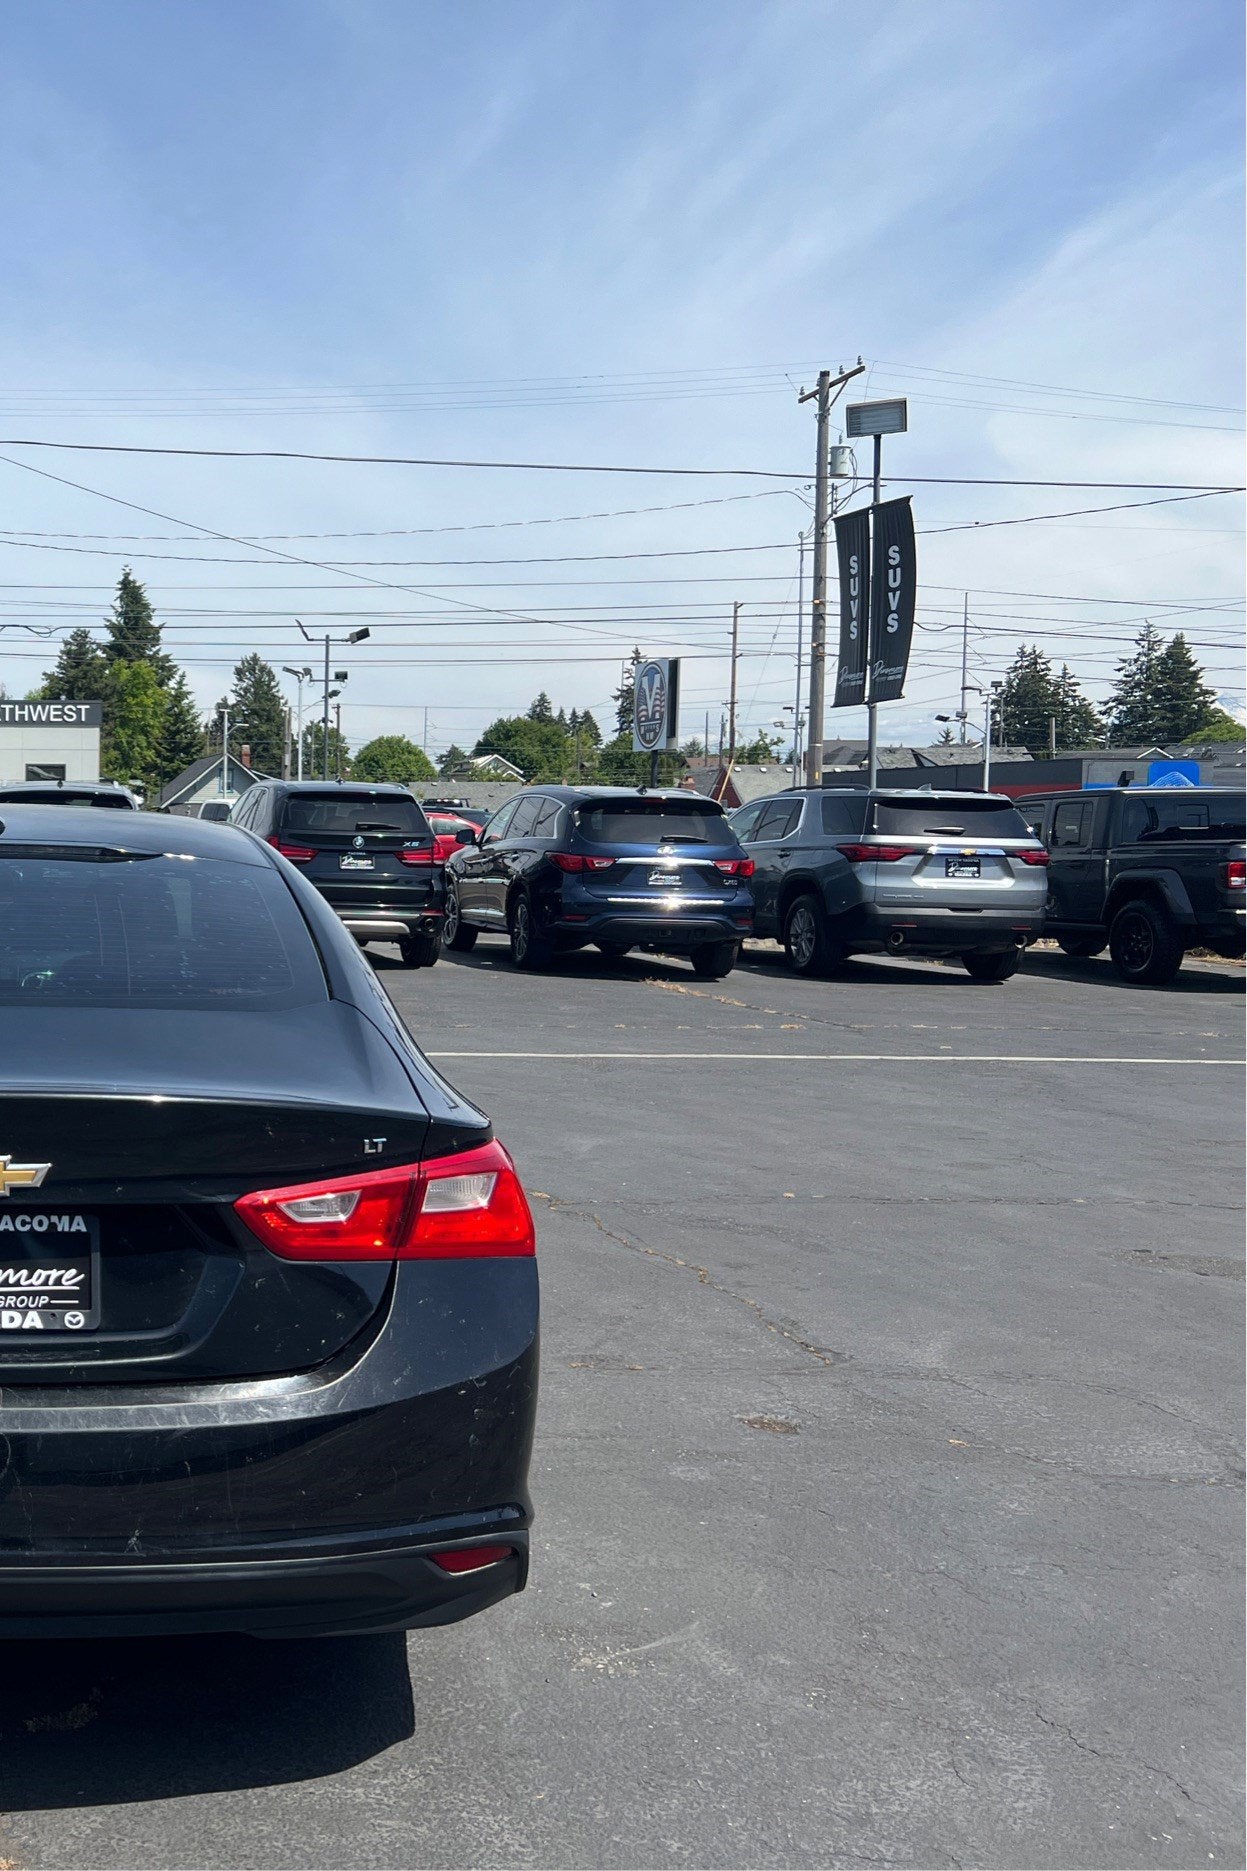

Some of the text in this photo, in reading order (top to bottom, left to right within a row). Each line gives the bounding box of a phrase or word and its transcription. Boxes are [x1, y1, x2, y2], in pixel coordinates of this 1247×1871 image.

[849, 555, 859, 640] SUVS
[887, 545, 901, 633] SUVS
[363, 1138, 387, 1154] LT
